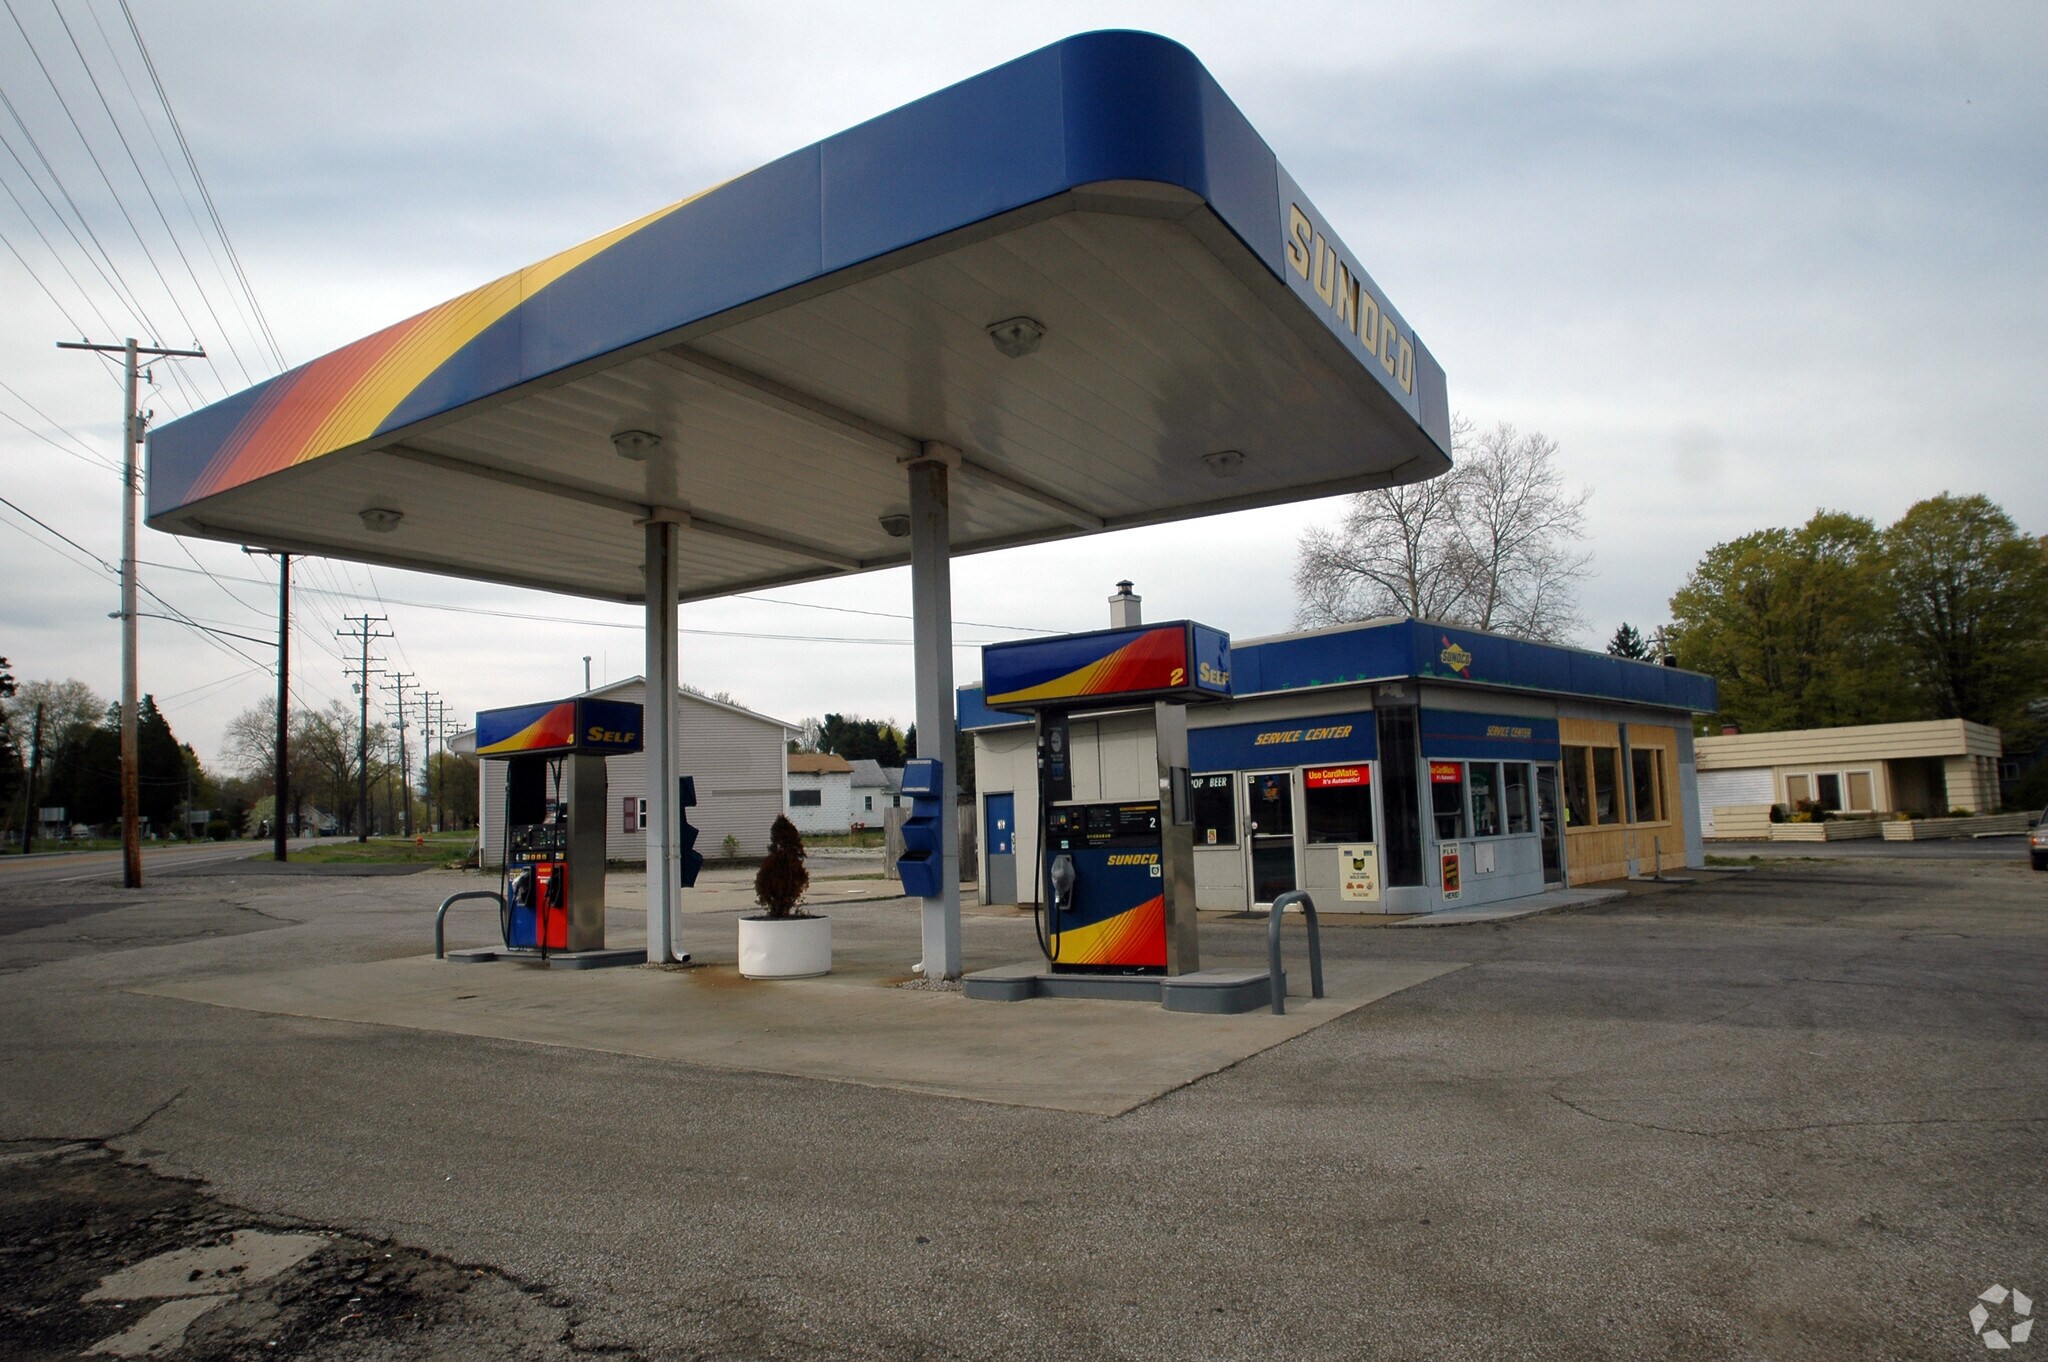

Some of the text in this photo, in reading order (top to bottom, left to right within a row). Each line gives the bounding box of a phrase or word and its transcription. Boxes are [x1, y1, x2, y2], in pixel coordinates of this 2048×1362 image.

[1287, 202, 1415, 397] SUNOCO
[1442, 650, 1470, 666] SUNOCO
[1170, 667, 1184, 687] 2
[1254, 725, 1352, 745] SERVICE CENTER
[1487, 726, 1532, 738] SERVICE CENTER
[1308, 770, 1322, 780] Use
[1209, 776, 1227, 788] BEER
[1149, 817, 1157, 829] 2
[1442, 847, 1458, 855] PLAY
[1107, 853, 1159, 866] SUNOCO
